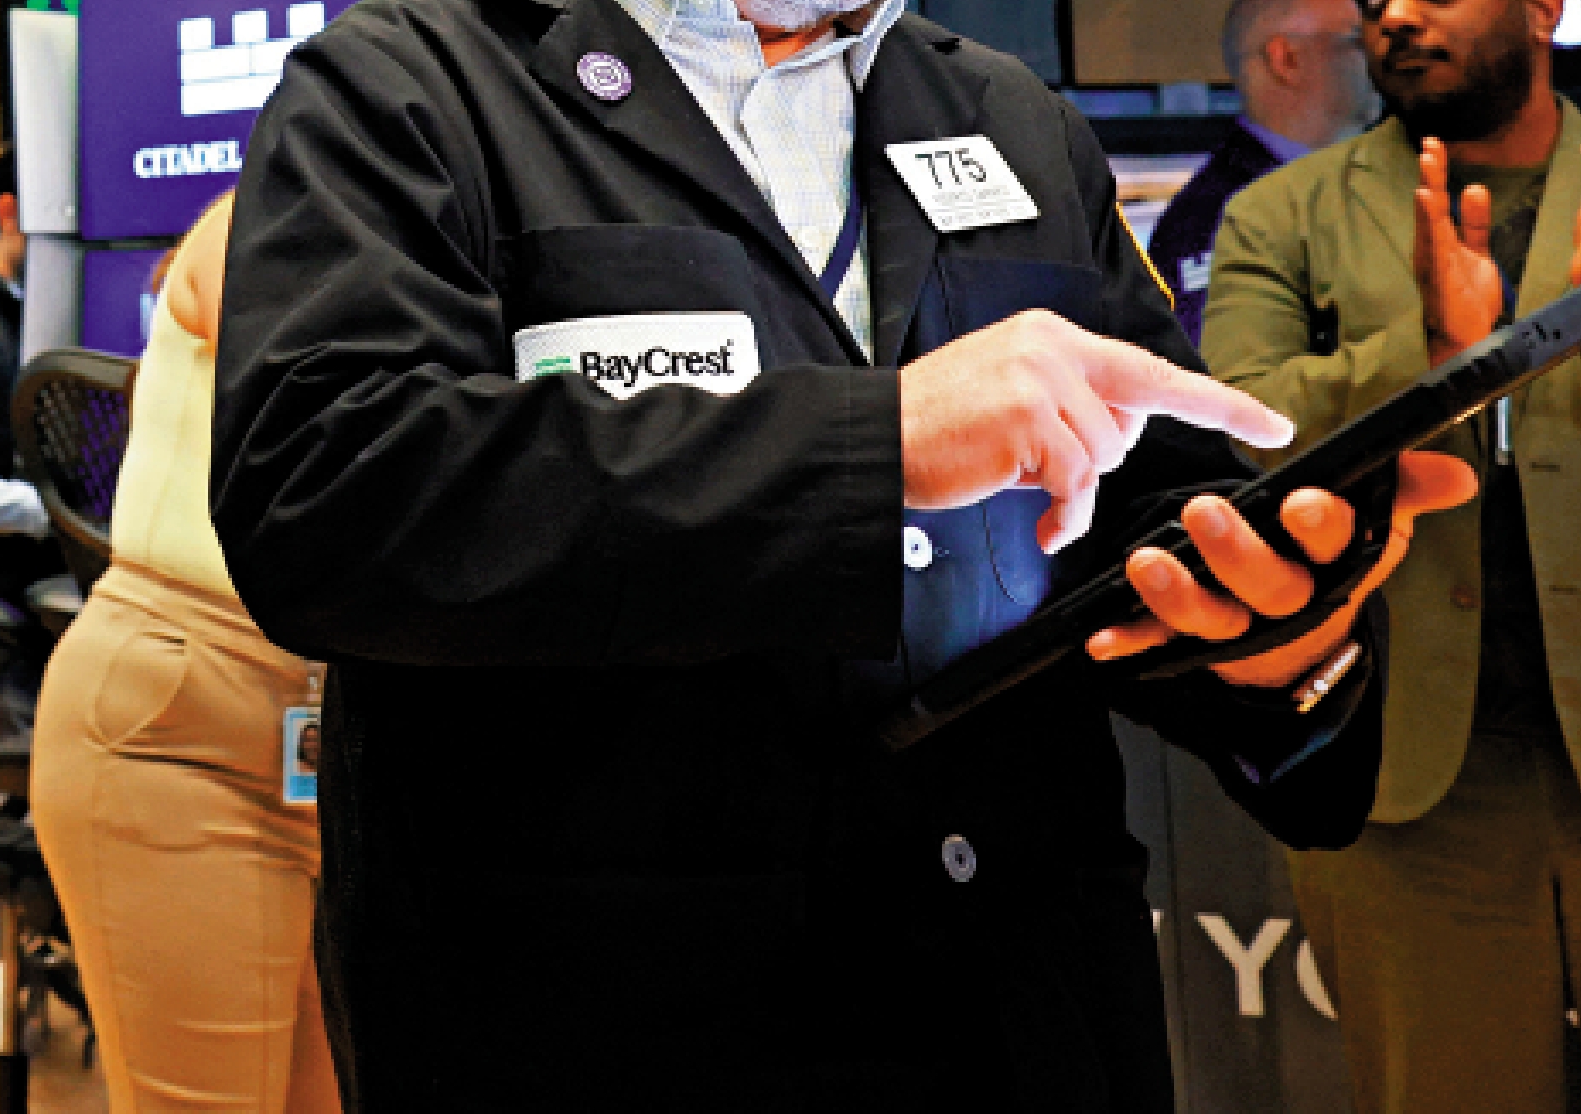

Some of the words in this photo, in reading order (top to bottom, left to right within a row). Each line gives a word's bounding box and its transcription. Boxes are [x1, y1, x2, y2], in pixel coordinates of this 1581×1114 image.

[133, 140, 243, 178] CITADEL
[914, 146, 988, 190] 775
[579, 345, 735, 389] BayCrest
